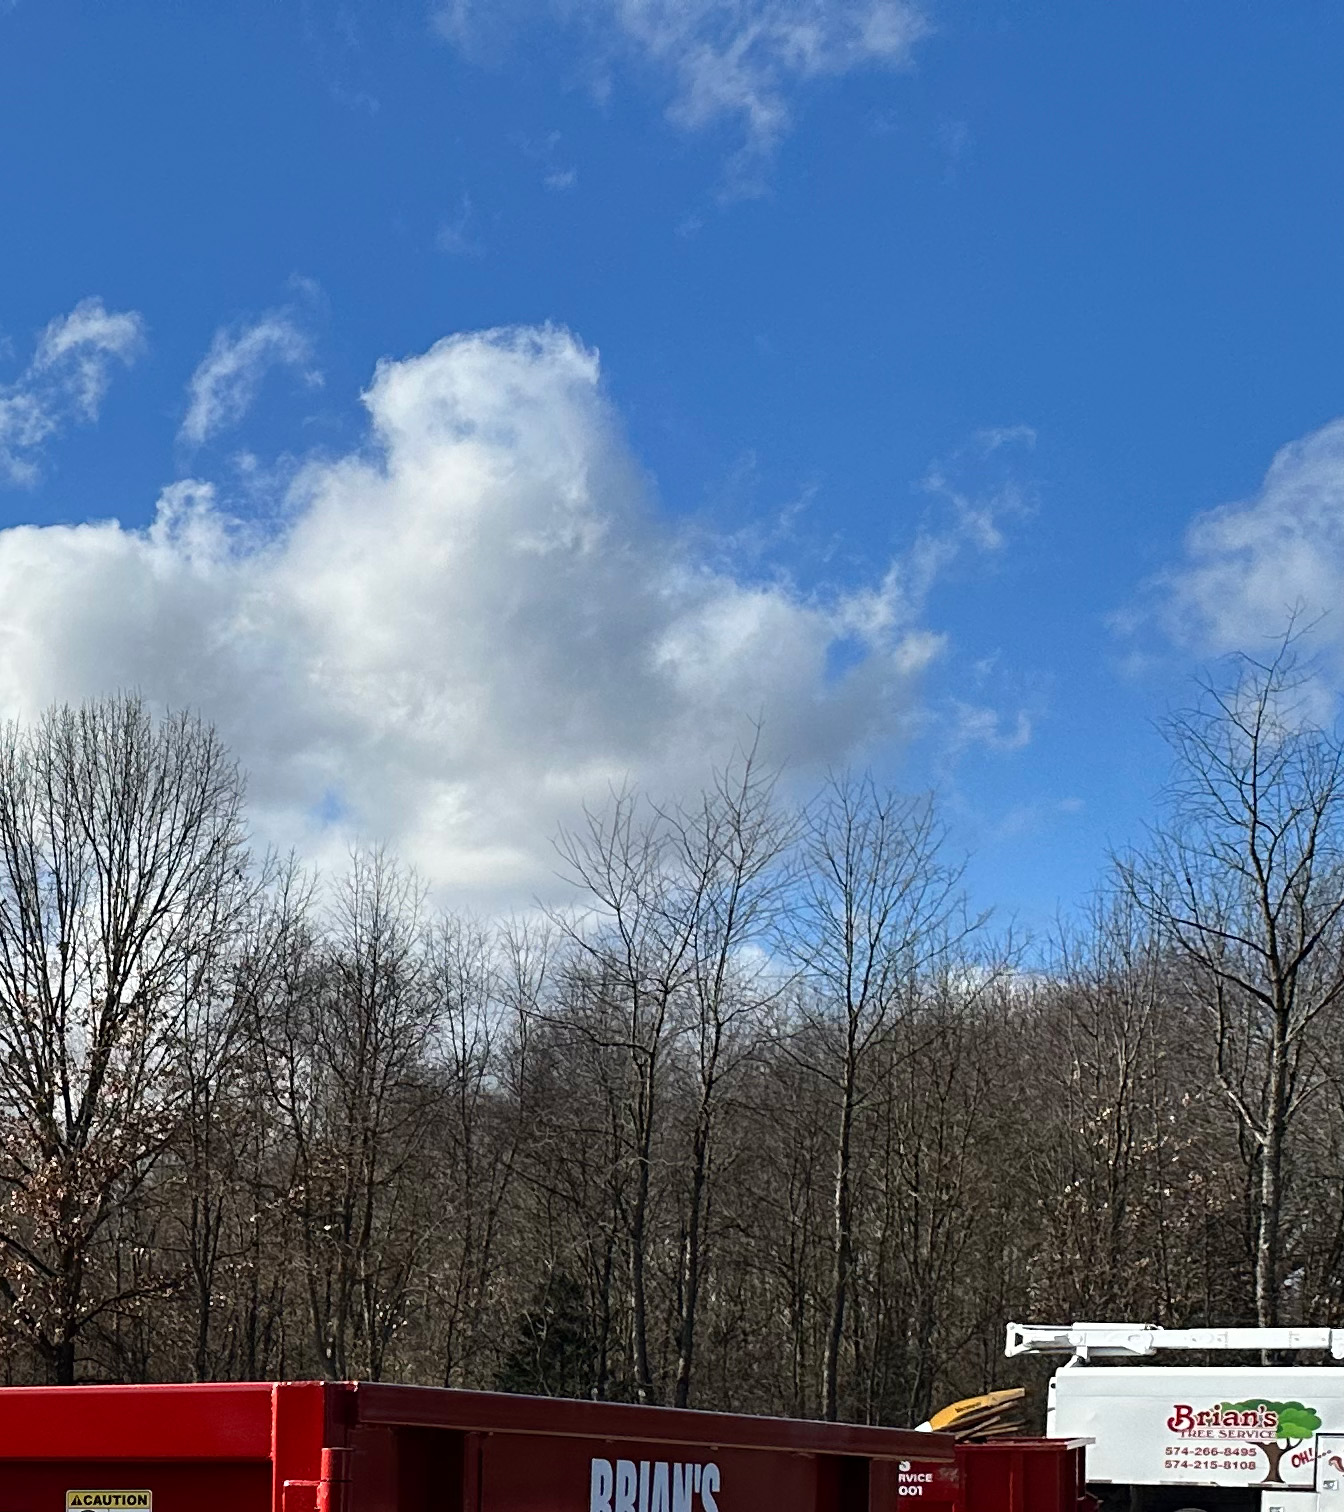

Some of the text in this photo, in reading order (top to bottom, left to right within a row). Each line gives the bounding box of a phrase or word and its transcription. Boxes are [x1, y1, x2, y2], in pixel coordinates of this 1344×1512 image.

[1167, 1404, 1278, 1433] Brian's
[1180, 1430, 1276, 1439] TREE SERVICE
[1165, 1446, 1257, 1457] 574-266-8495
[1291, 1447, 1313, 1468] OH!
[1164, 1460, 1257, 1470] 574-215-8108
[83, 1494, 148, 1506] CAUTION
